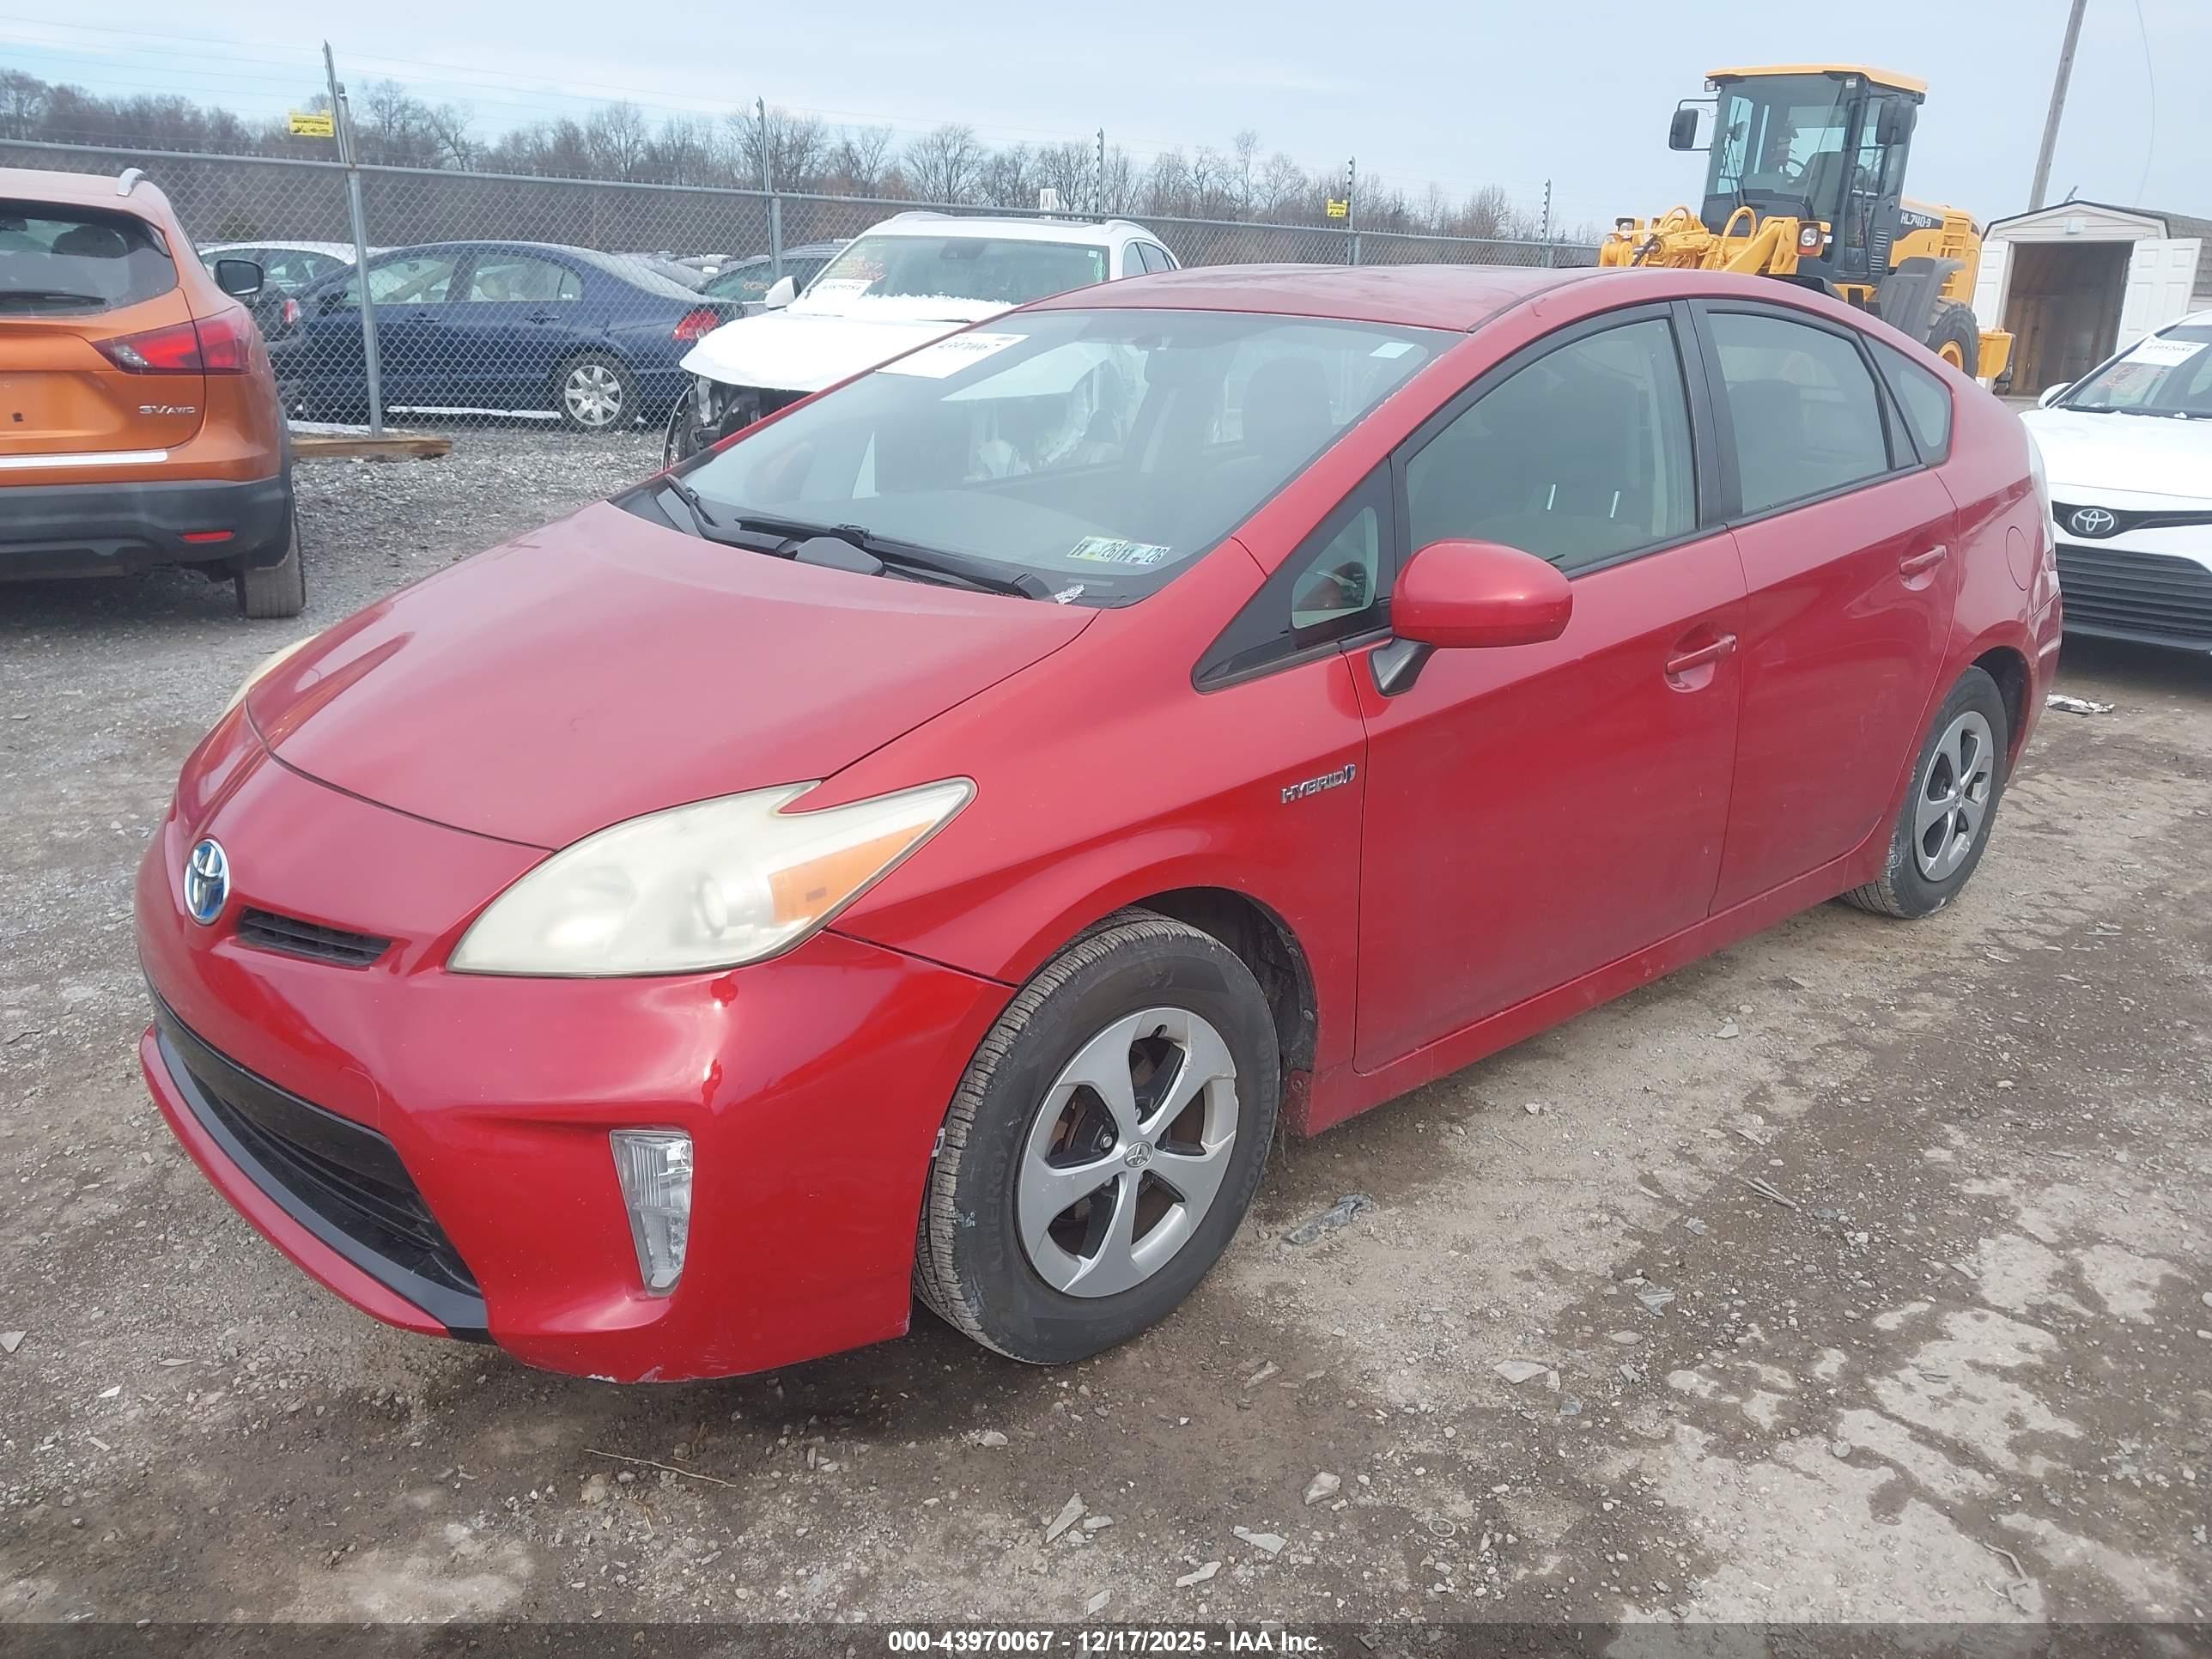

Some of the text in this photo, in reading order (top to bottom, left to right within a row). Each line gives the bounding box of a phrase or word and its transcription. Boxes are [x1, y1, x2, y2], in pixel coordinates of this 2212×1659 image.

[1900, 211, 1932, 228] HL740-9
[138, 404, 167, 414] SV
[1281, 770, 1345, 804] HYBRID
